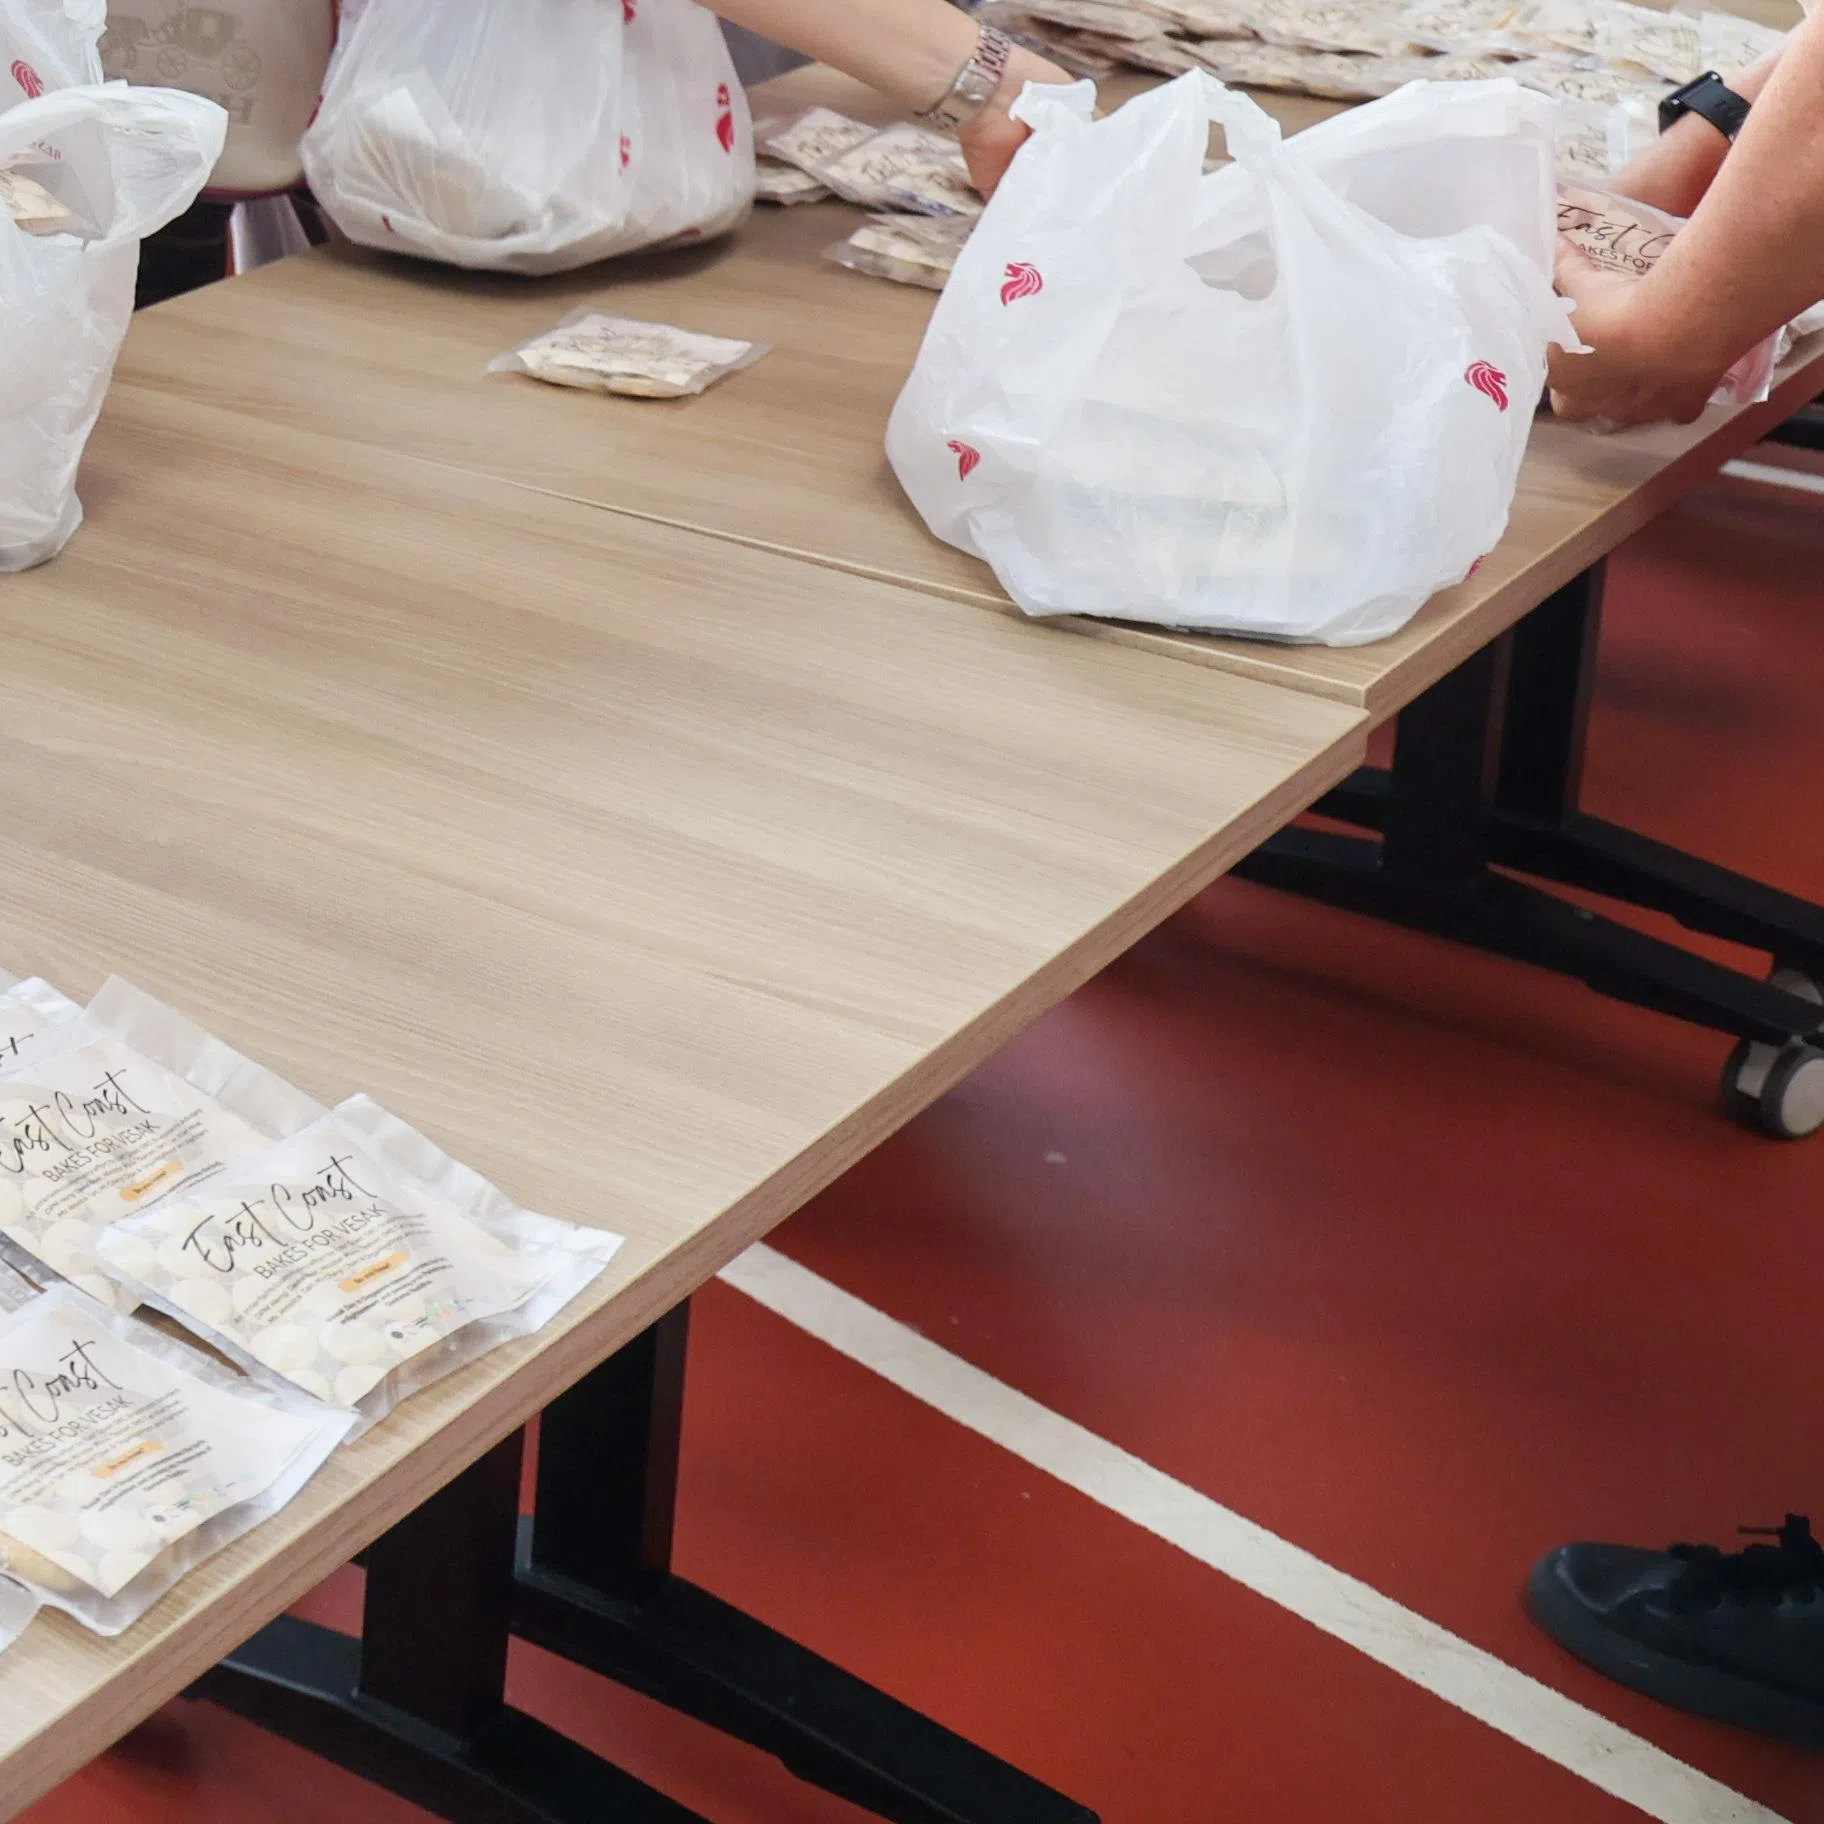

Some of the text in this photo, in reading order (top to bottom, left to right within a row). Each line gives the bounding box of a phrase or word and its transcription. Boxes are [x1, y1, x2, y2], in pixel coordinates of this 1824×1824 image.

[1579, 243, 1619, 261] AKES
[53, 1067, 152, 1146] Coast
[41, 1118, 161, 1183] BAKES FOR VESAK
[181, 1196, 287, 1274] East
[267, 1154, 381, 1234] Coast
[253, 1202, 389, 1280] BAKES FOR VESAK
[11, 1338, 124, 1423] Coast
[2, 1394, 136, 1468] BAKES FOR VESAK
